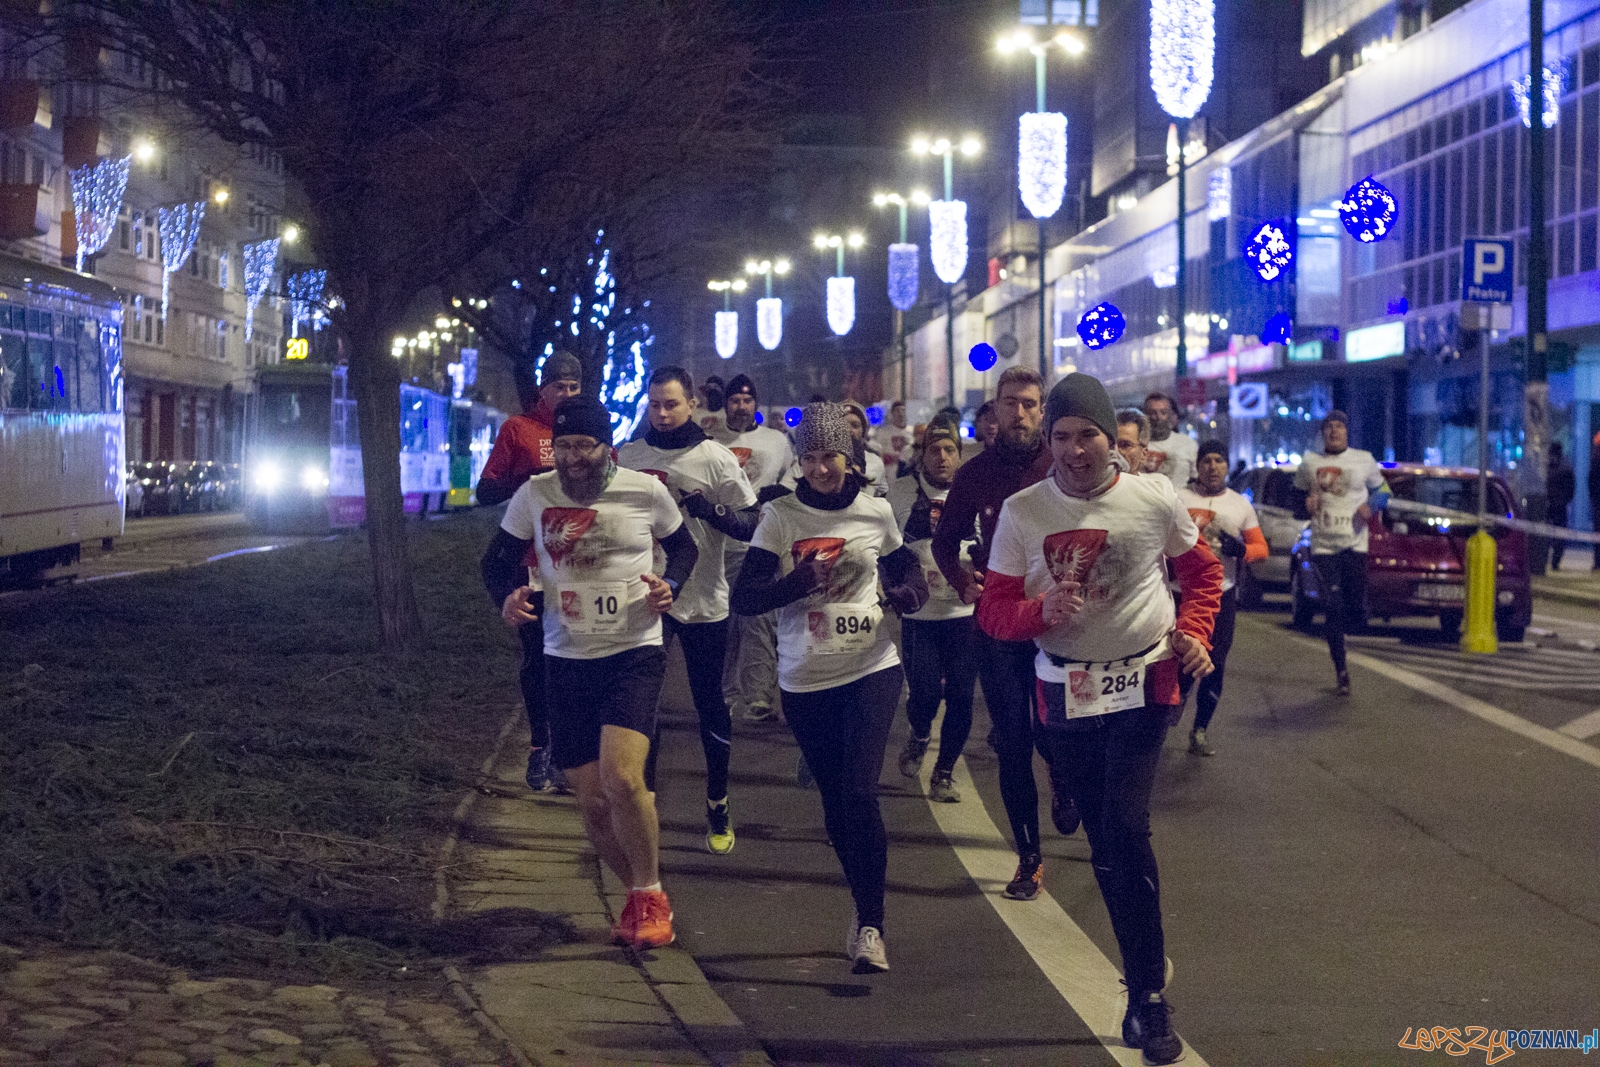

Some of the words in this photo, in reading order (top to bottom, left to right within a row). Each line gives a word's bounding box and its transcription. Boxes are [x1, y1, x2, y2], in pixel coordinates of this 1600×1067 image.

[1474, 242, 1505, 285] P
[286, 338, 309, 360] 20
[594, 596, 618, 615] 10
[835, 616, 872, 635] 894
[1101, 671, 1140, 696] 284
